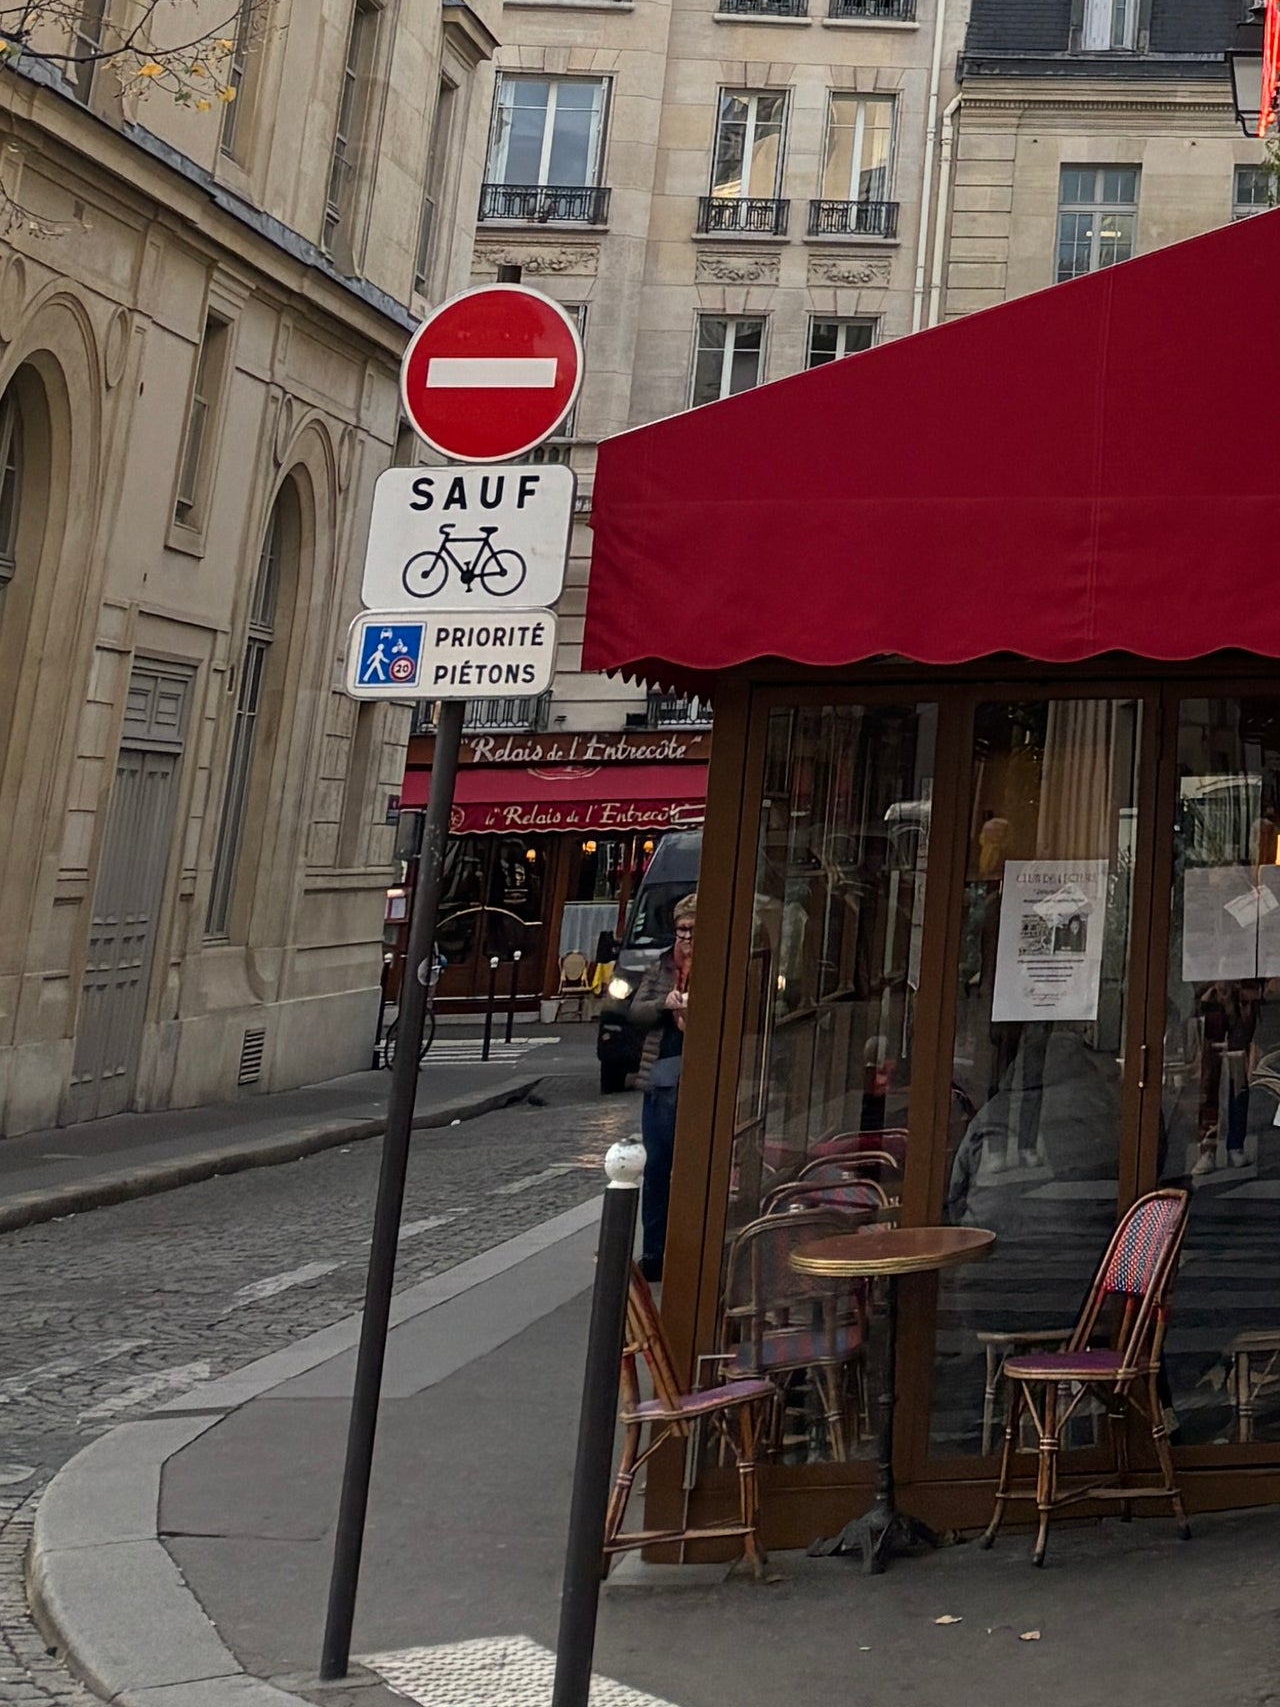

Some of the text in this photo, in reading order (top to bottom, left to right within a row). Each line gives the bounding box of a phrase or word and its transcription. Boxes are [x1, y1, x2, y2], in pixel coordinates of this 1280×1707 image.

[409, 474, 541, 512] SAUF
[434, 622, 545, 647] PRIORITÉ
[396, 664, 409, 674] 20
[433, 660, 536, 685] PIÉTONS
[547, 743, 562, 761] de
